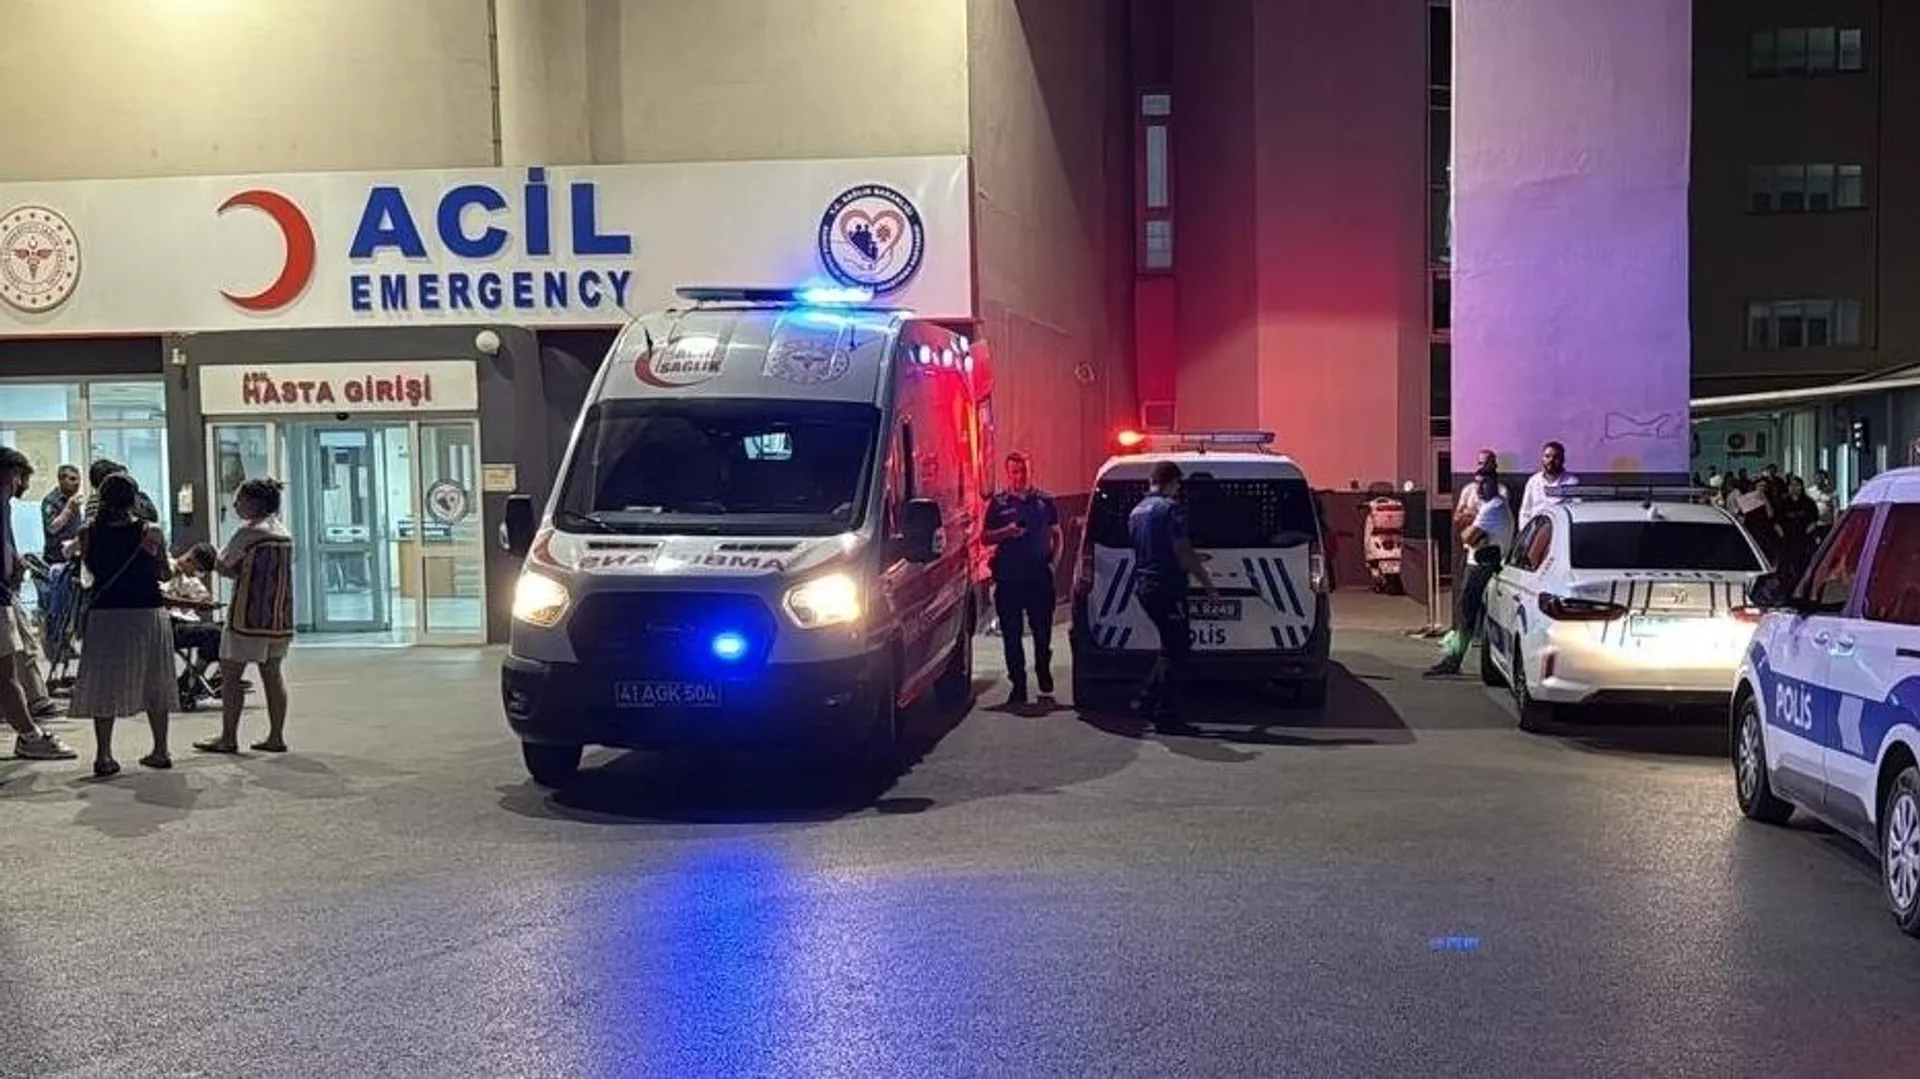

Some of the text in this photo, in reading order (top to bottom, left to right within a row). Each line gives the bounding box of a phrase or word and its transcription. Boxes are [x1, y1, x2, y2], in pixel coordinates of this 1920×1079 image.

[349, 167, 632, 258] ACİL
[350, 270, 632, 311] EMERGENCY
[243, 374, 432, 406] HASTA GİRİŞİ
[1188, 623, 1227, 645] OLİS
[1775, 682, 1812, 731] POLİS
